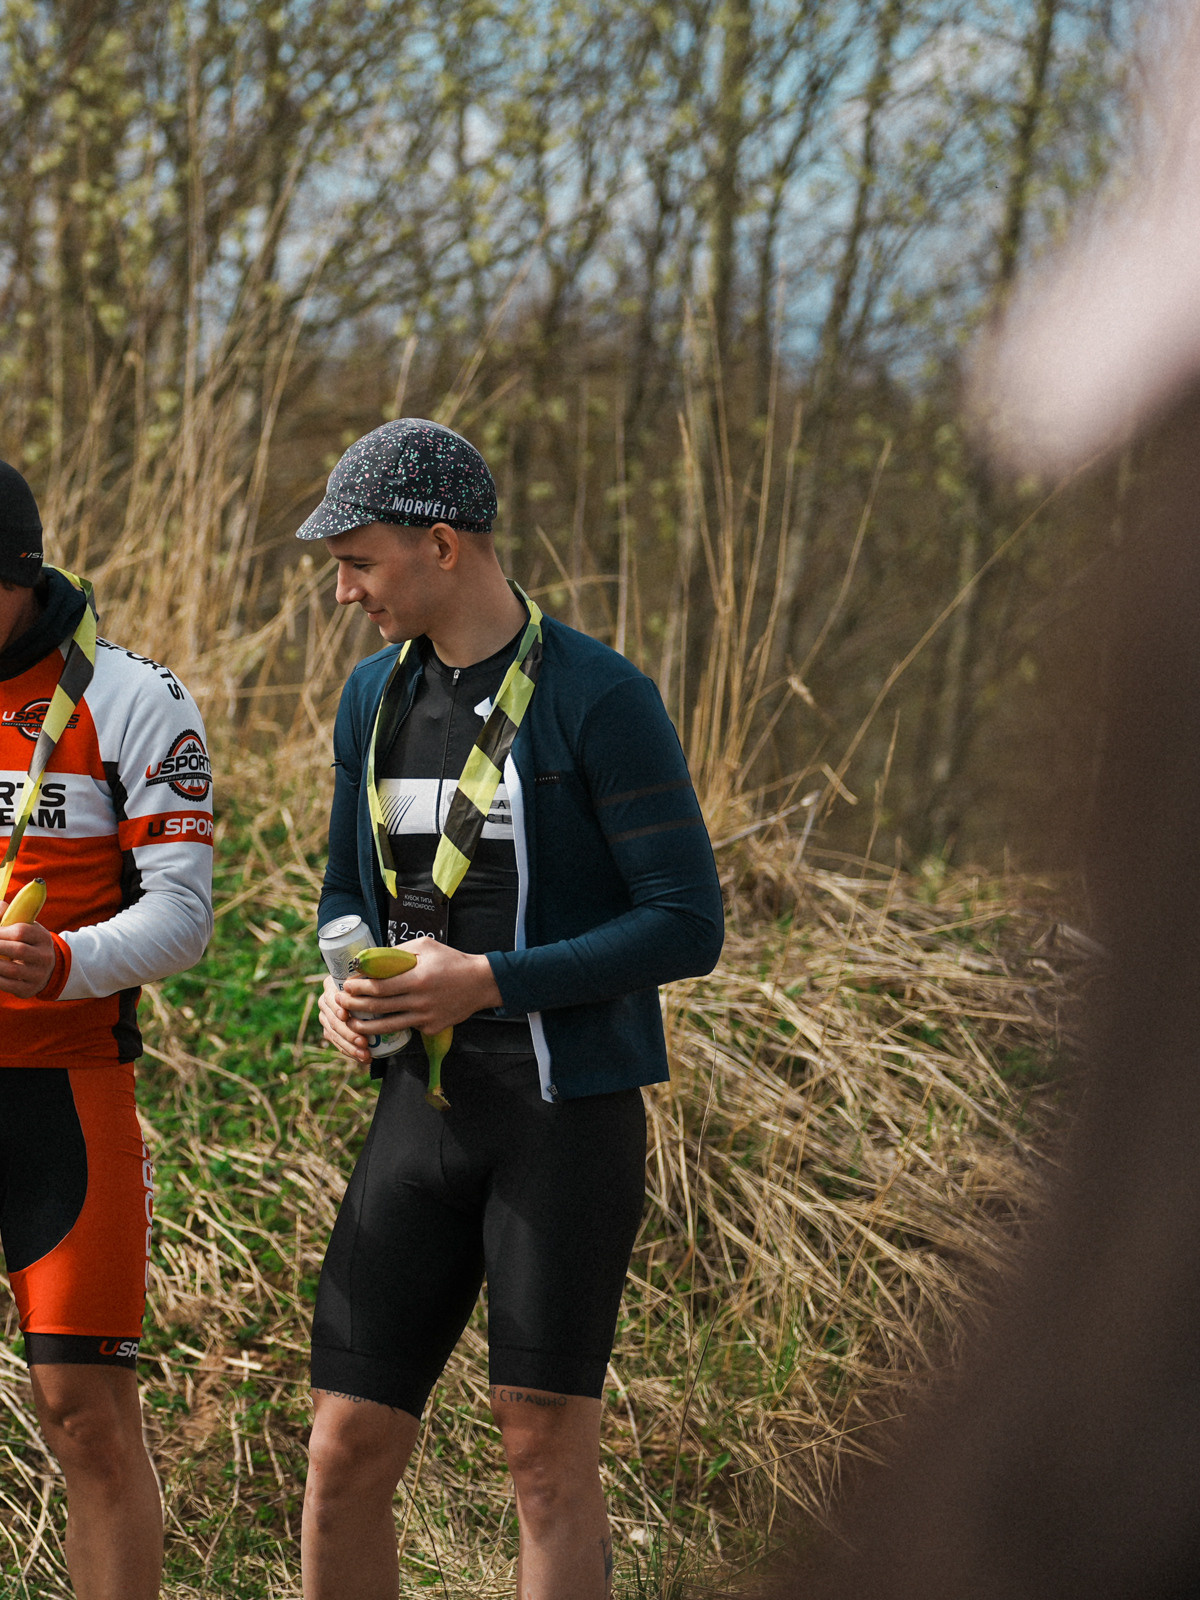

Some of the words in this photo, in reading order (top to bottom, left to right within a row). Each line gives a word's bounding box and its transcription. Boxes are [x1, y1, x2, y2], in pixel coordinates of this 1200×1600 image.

[391, 496, 457, 520] MORVÉLO
[2, 710, 81, 723] USPOS
[145, 753, 212, 779] USPORT
[499, 1388, 568, 1407] СТРАШНО
